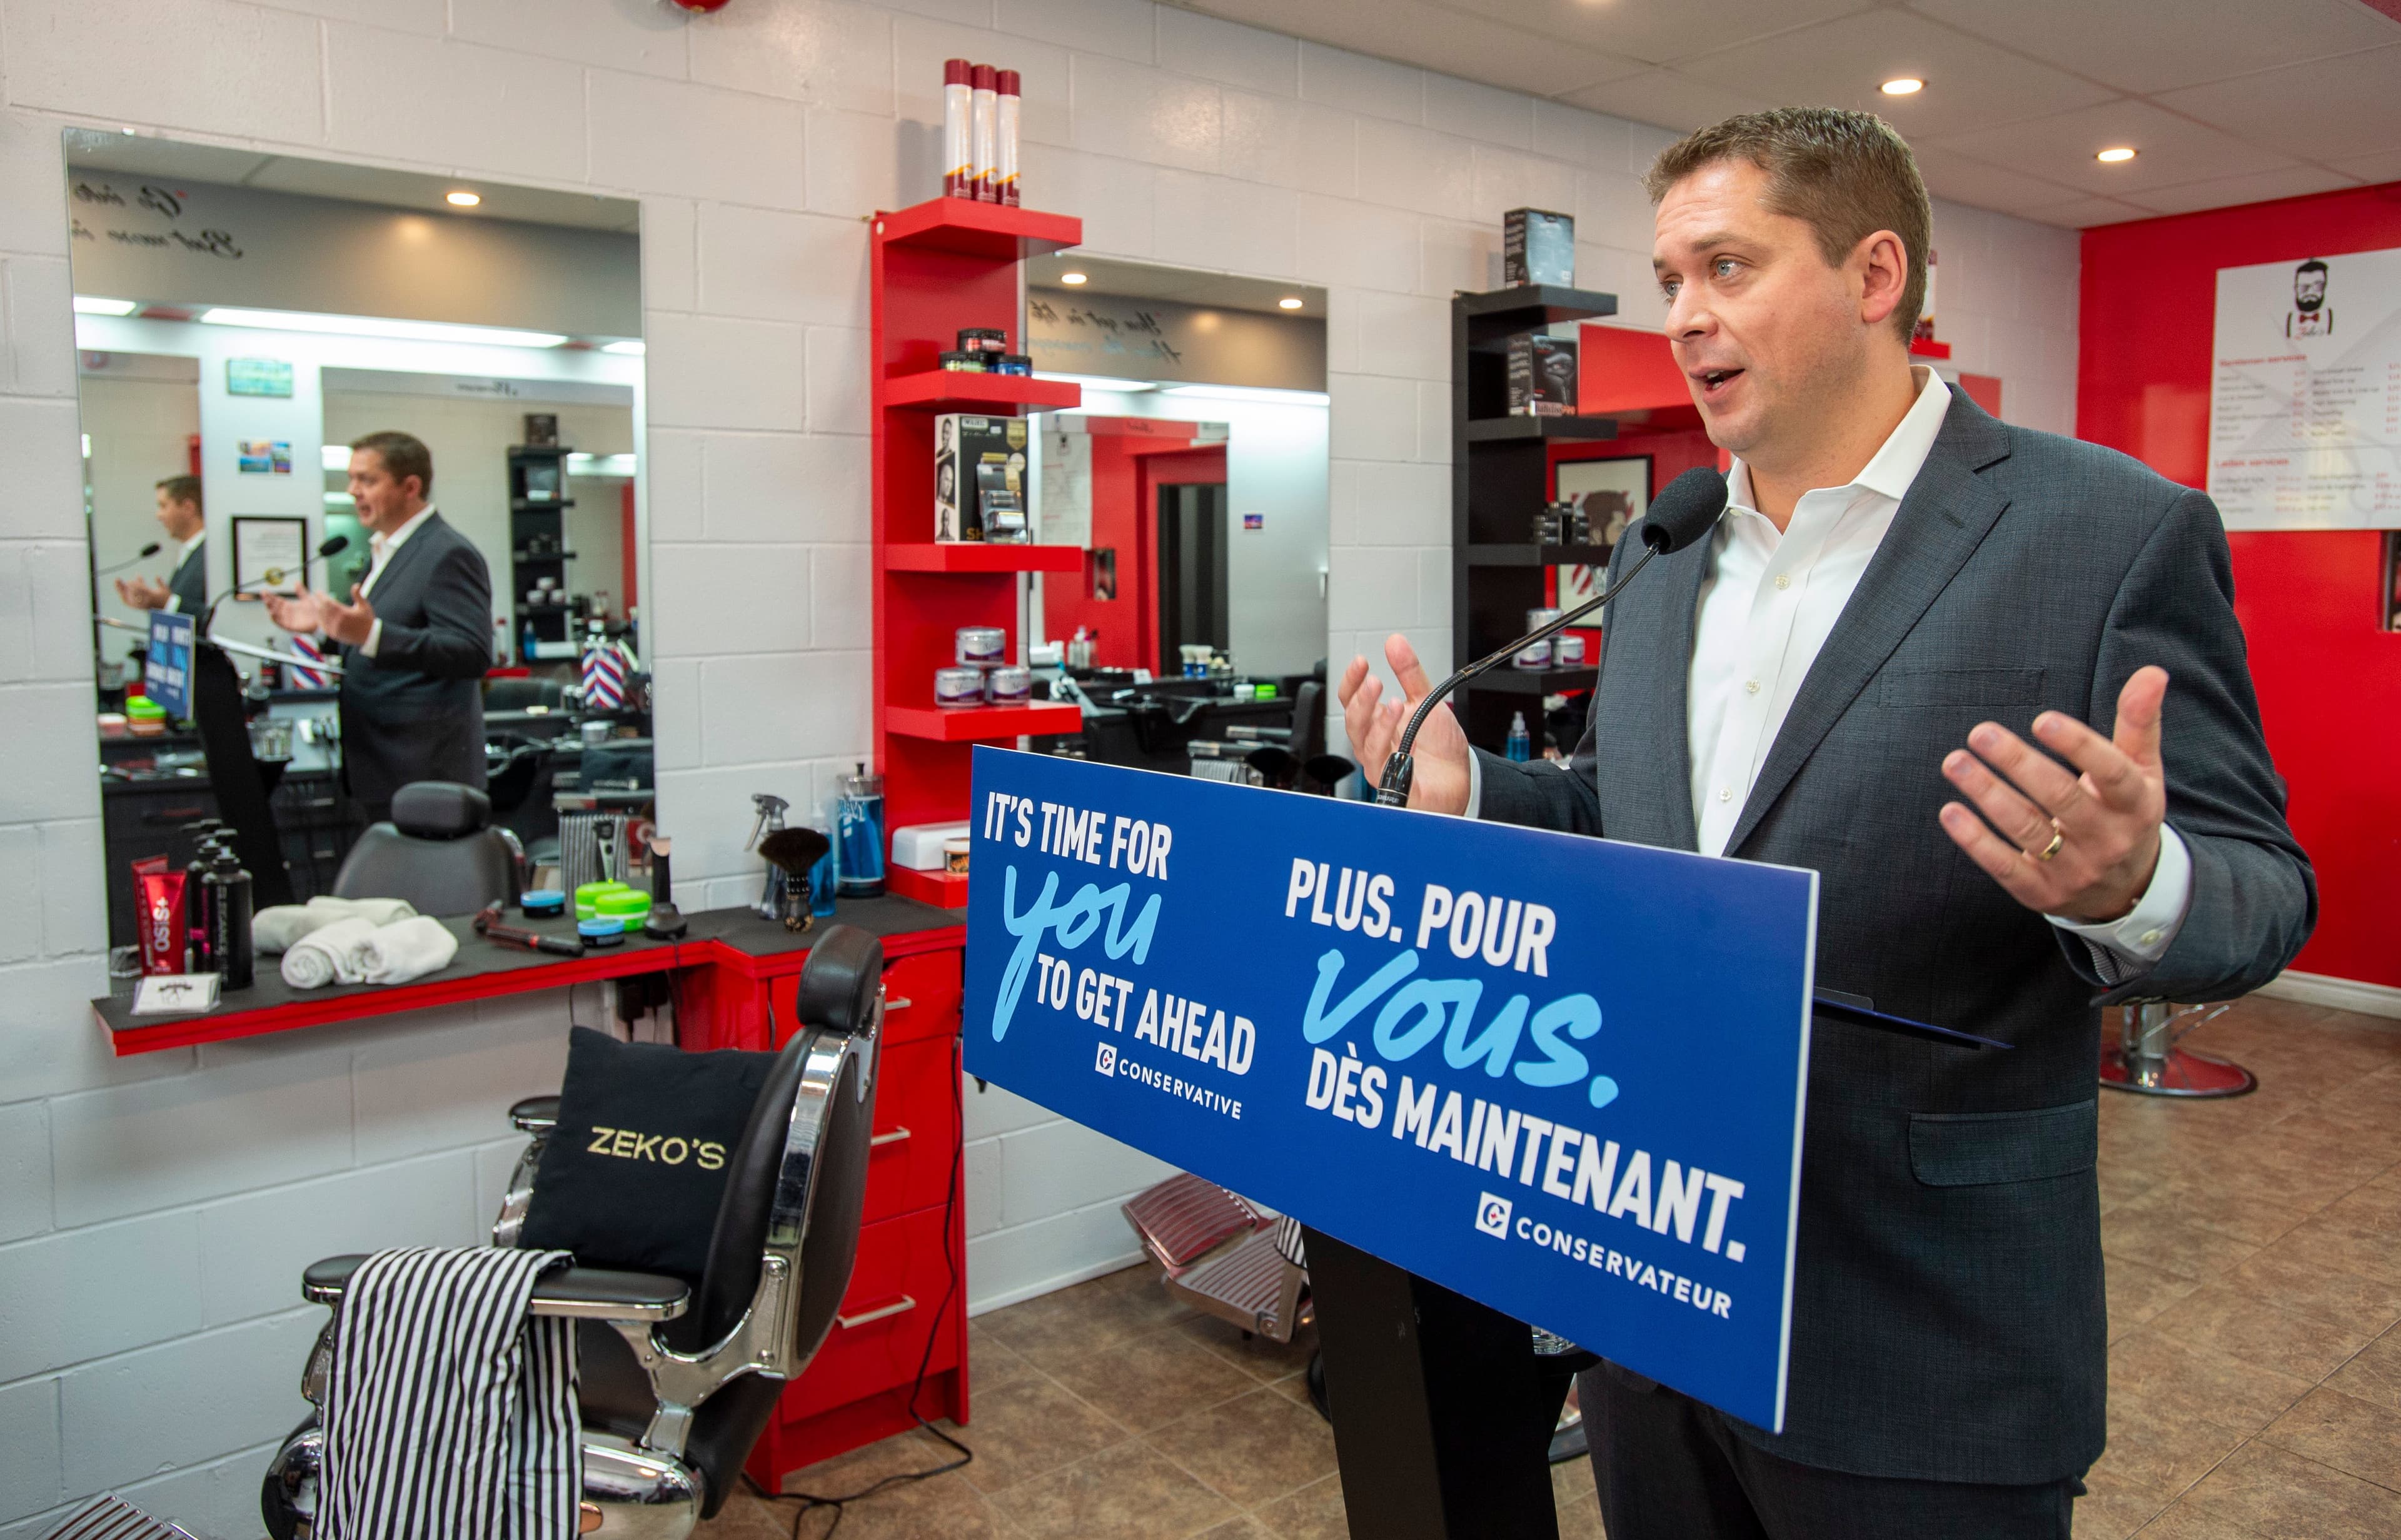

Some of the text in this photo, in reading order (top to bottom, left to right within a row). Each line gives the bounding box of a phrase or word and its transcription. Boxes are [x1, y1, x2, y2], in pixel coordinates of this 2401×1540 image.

[984, 791, 1172, 881] IT'S TIME FOR
[992, 865, 1162, 1043] you
[1285, 857, 1556, 978] PLUS. POUR
[1037, 953, 1256, 1075] TO GET AHEAD
[1119, 1059, 1242, 1120] CONSERVATIVE
[586, 1126, 727, 1170] ZEKO'S
[1305, 1041, 1746, 1262] DÈS MAINTENANT.
[1516, 1217, 1731, 1319] CONSERVATEUR
